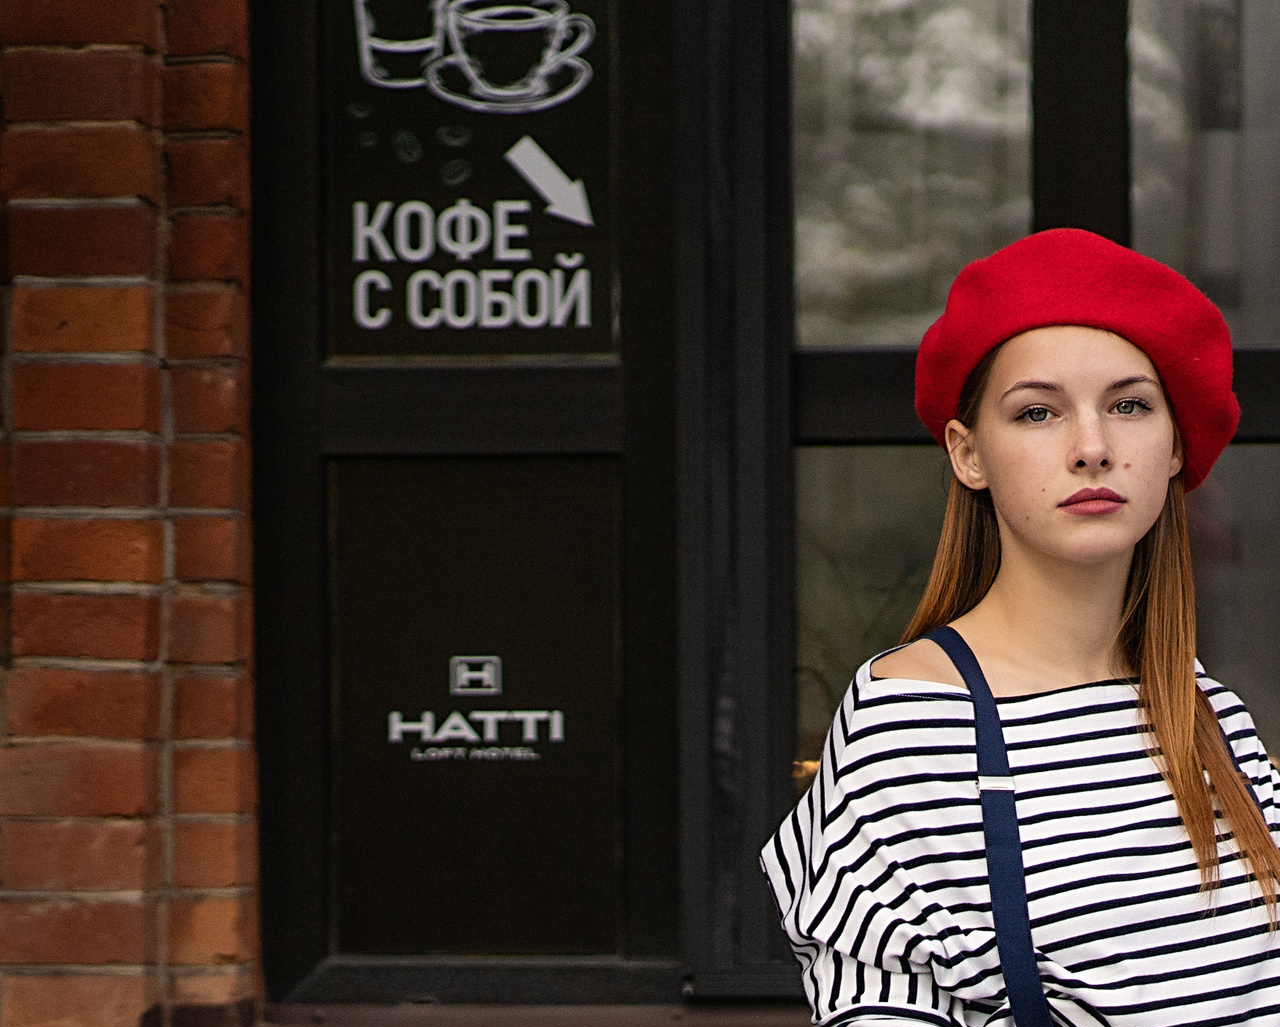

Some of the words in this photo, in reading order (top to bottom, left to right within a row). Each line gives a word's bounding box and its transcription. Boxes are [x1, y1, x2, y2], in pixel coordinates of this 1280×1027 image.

[353, 199, 531, 263] КОФЕ
[354, 271, 392, 330] С
[406, 254, 591, 330] СОБОЙ
[388, 710, 564, 742] HATTI
[410, 746, 467, 761] LOFT
[469, 746, 540, 761] HOTEL
